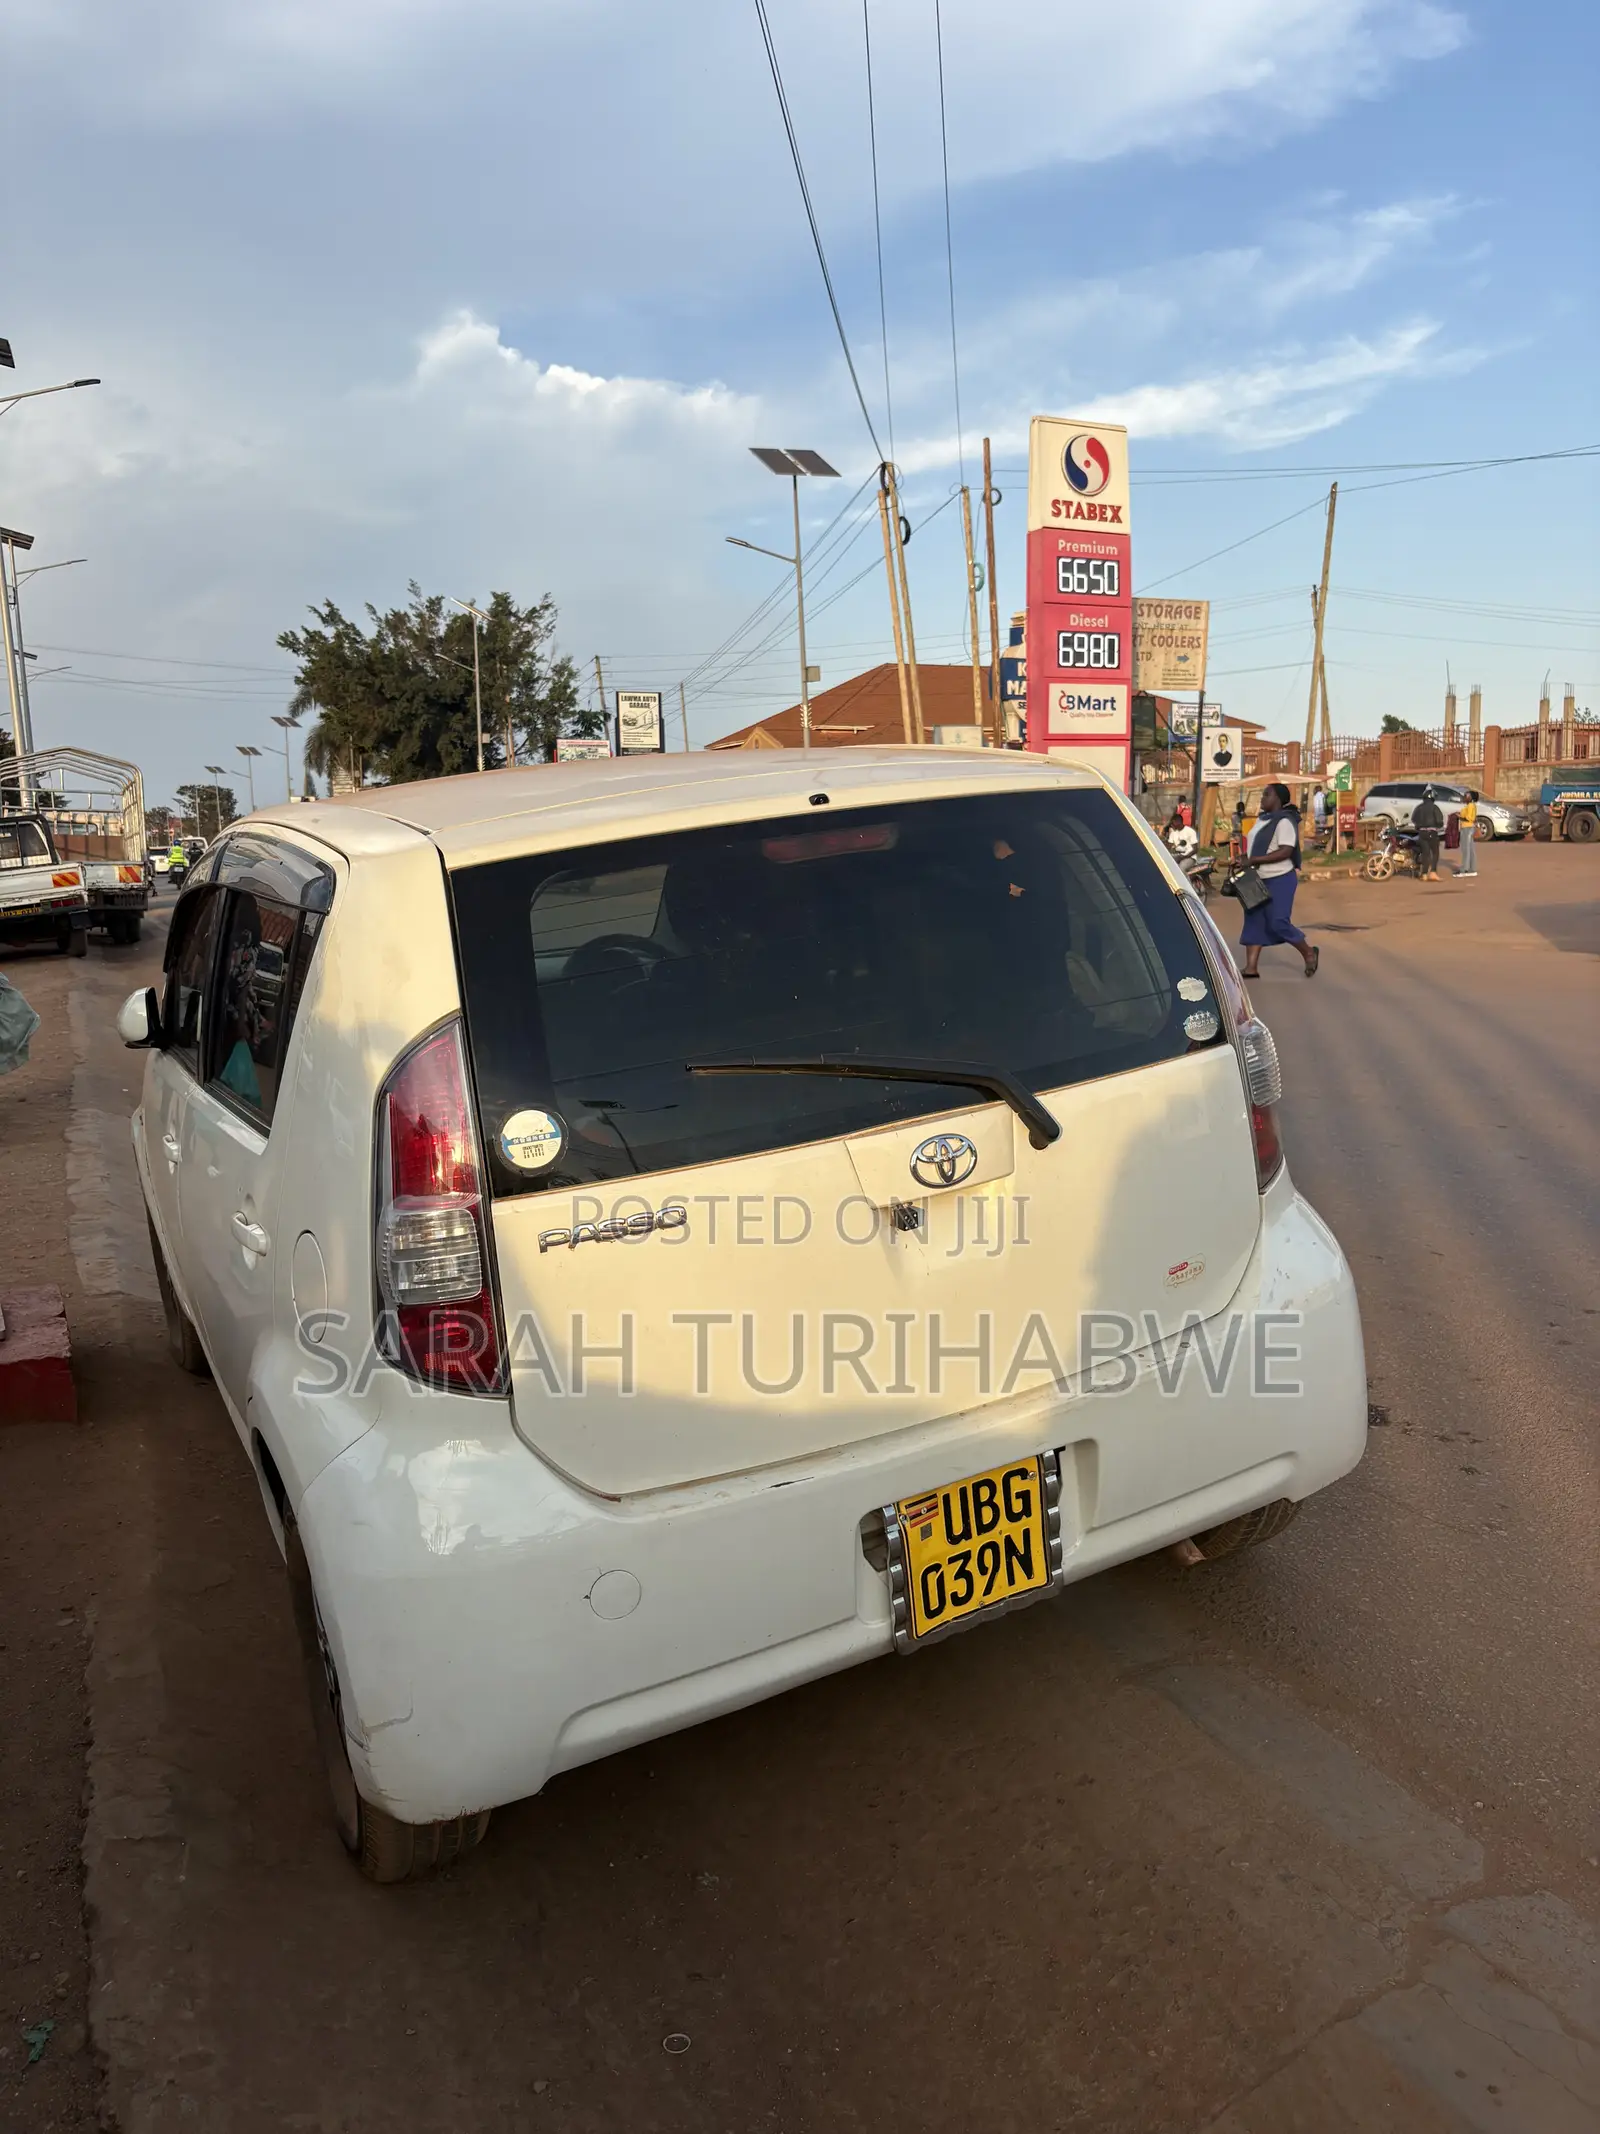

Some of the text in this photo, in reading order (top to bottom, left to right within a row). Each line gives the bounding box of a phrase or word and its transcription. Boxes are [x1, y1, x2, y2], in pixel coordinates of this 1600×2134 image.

[1050, 498, 1123, 524] STABEX
[1057, 539, 1119, 556] Premium
[1058, 557, 1119, 596] 6650
[1069, 612, 1109, 629] Diesel
[1136, 603, 1202, 621] STORAGE
[1058, 631, 1120, 669] 6980
[1150, 634, 1202, 650] COOLERS
[1017, 661, 1027, 677] K
[1006, 679, 1027, 696] MA
[537, 1205, 689, 1254] PASSO
[941, 1466, 1033, 1546] UBG
[920, 1527, 1035, 1620] 039N
